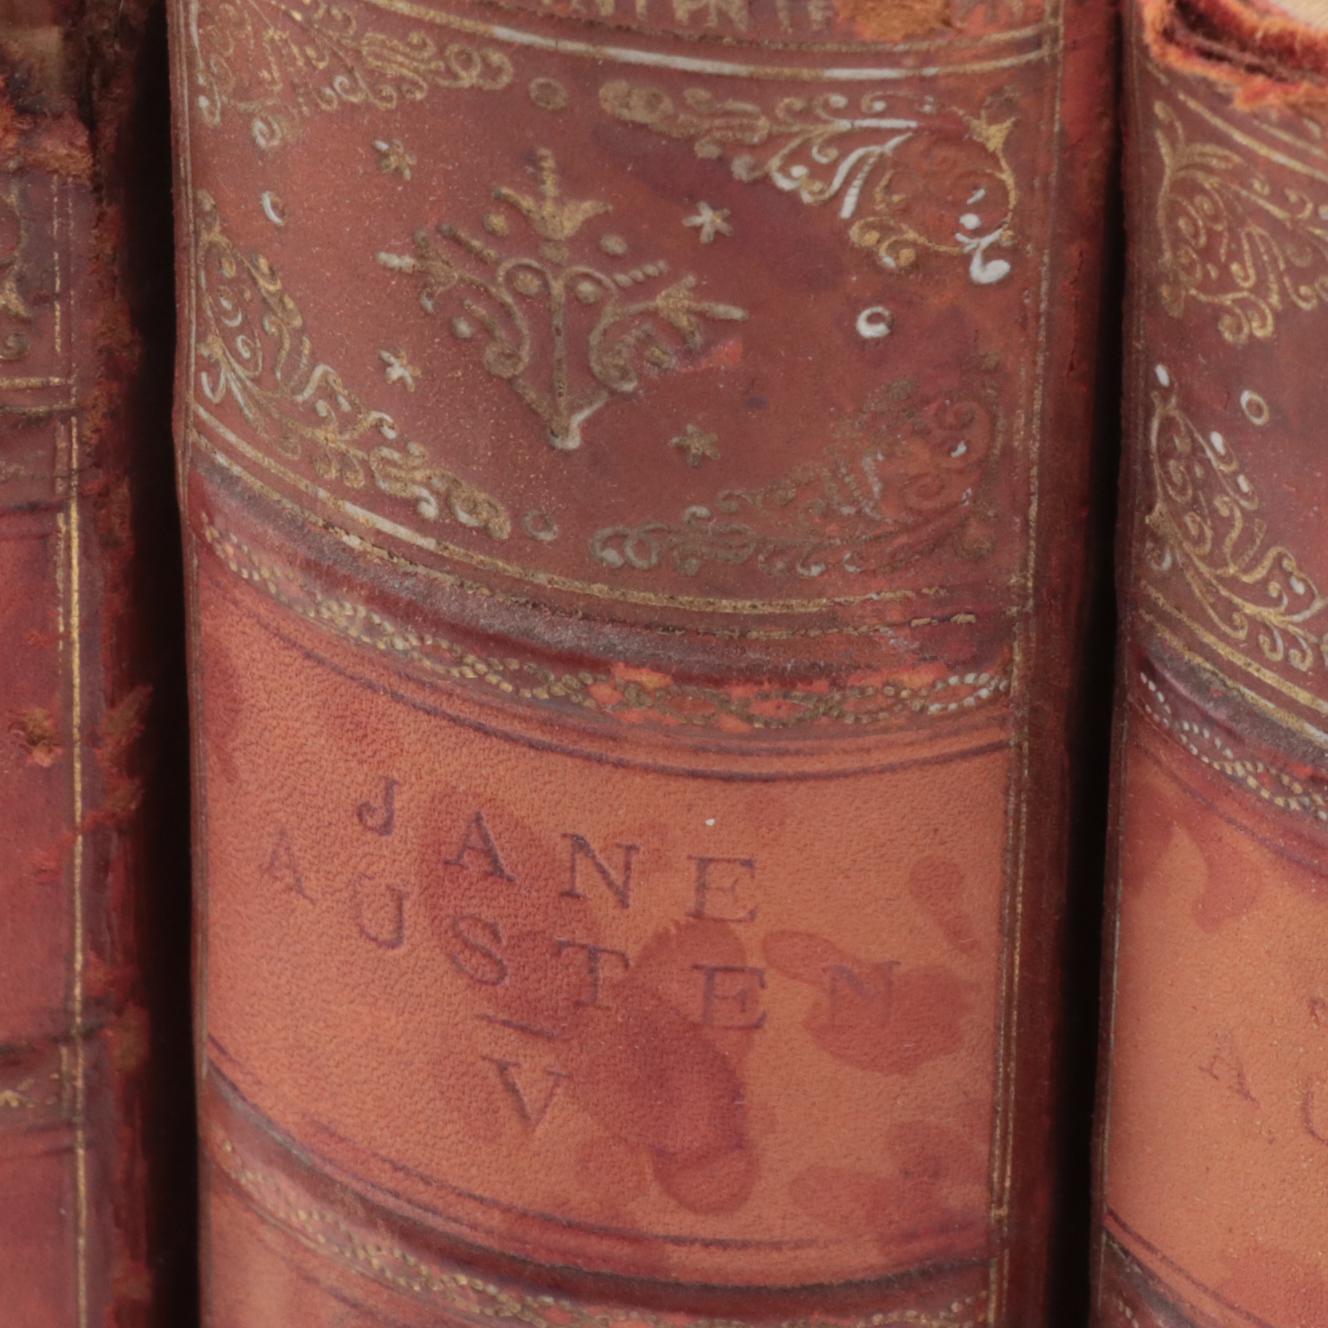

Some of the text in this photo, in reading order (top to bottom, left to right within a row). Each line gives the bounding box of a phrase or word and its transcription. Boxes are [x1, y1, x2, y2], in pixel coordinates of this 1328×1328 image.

[354, 775, 758, 924] JANE
[259, 826, 901, 1032] AUSTEN
[480, 1052, 572, 1138] V
